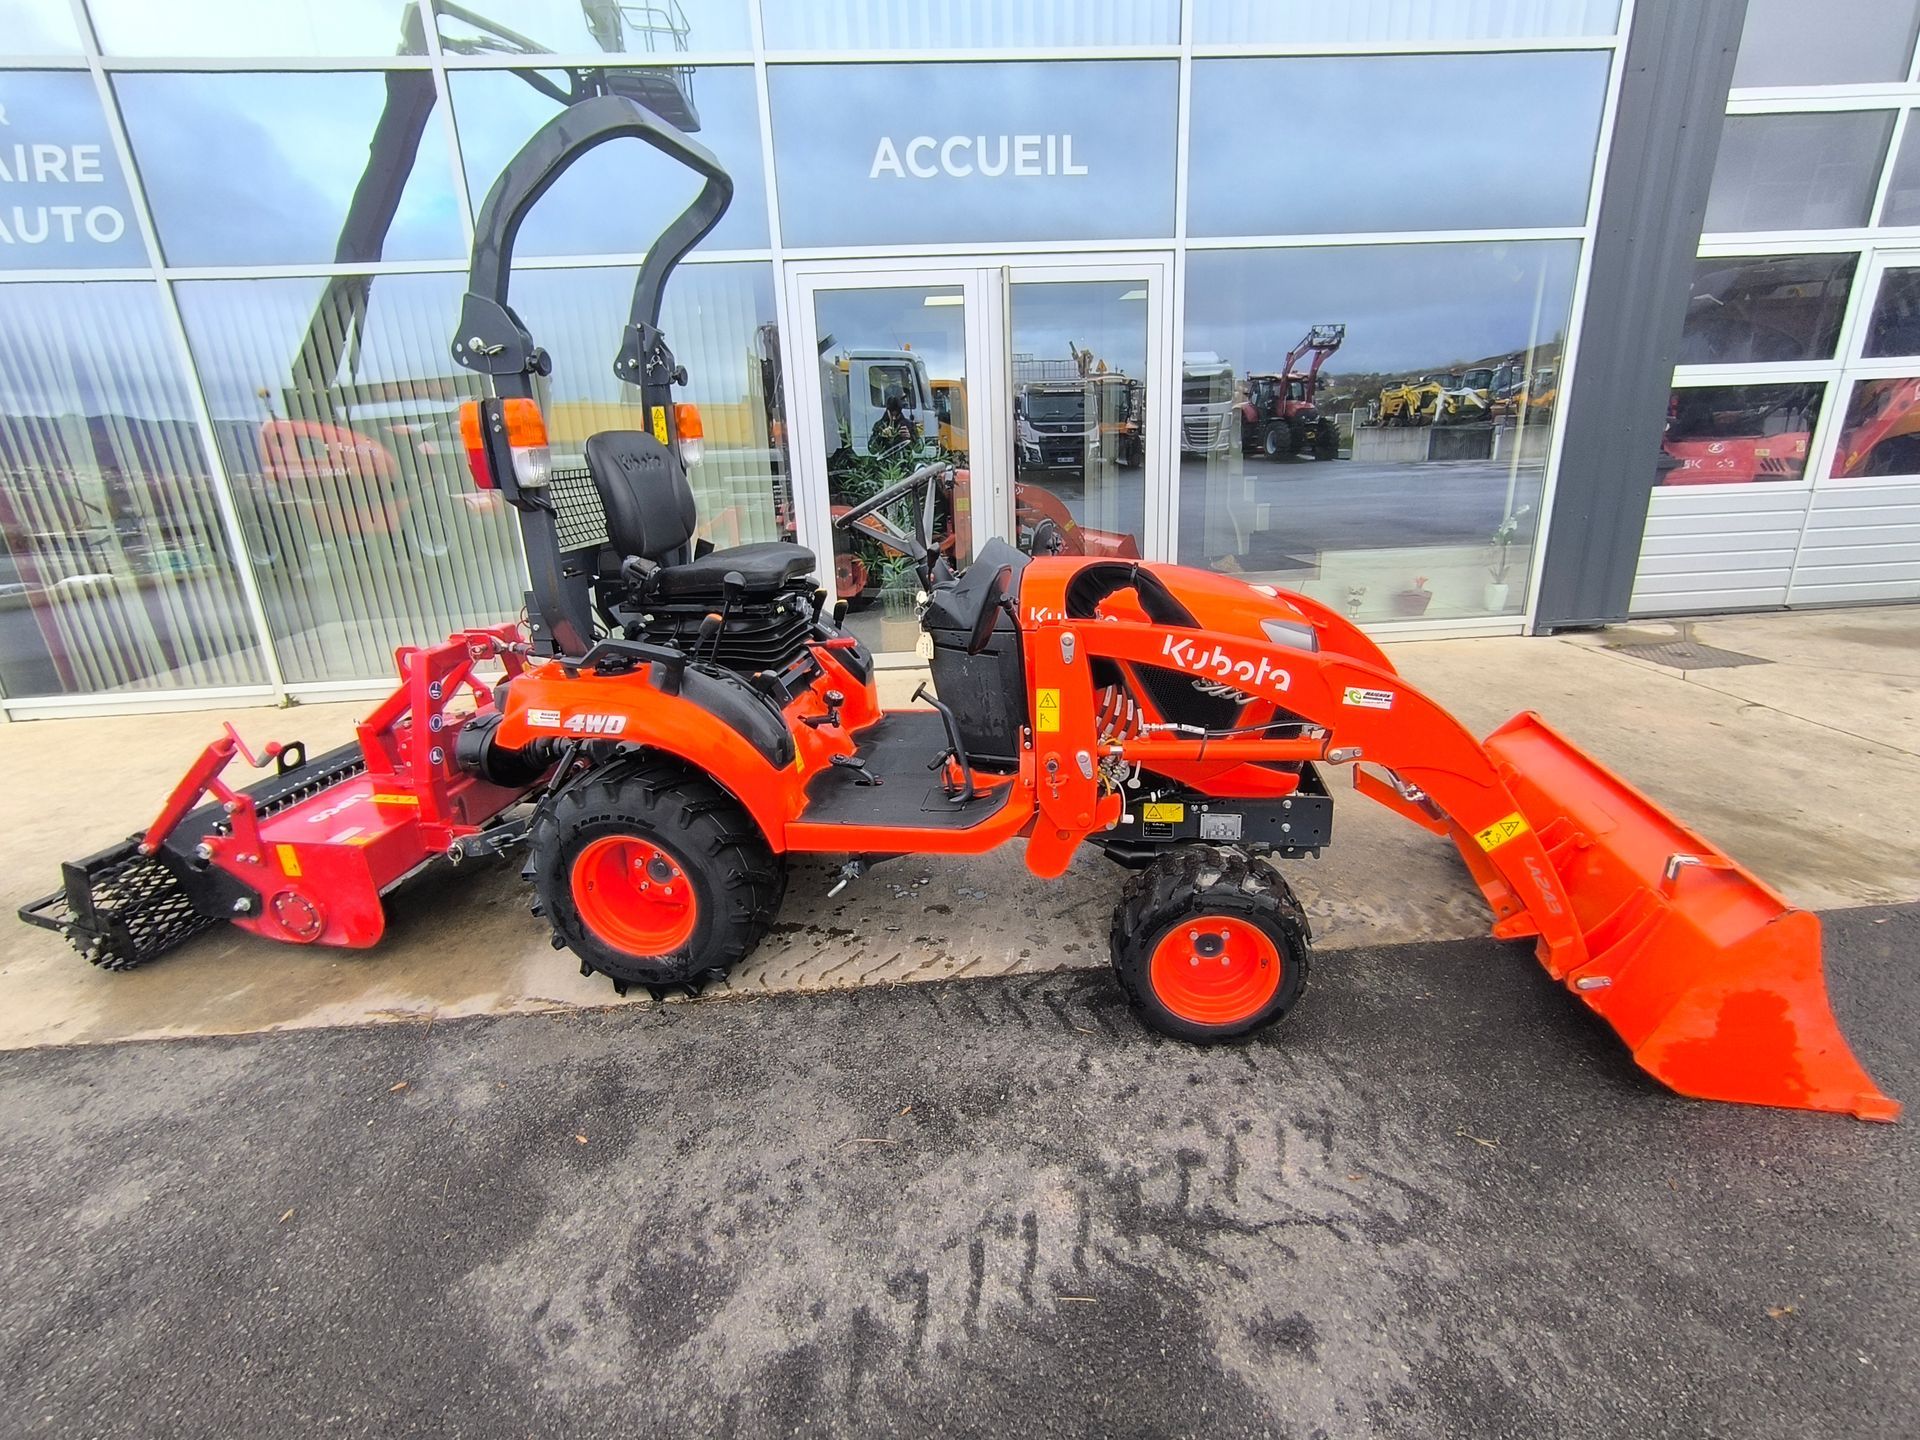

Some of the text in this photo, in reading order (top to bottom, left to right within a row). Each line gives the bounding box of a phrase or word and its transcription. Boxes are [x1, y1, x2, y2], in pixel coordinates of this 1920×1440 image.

[868, 134, 1089, 179] ACCUEIL
[1162, 633, 1292, 692] Kubota
[562, 713, 628, 735] 4WD
